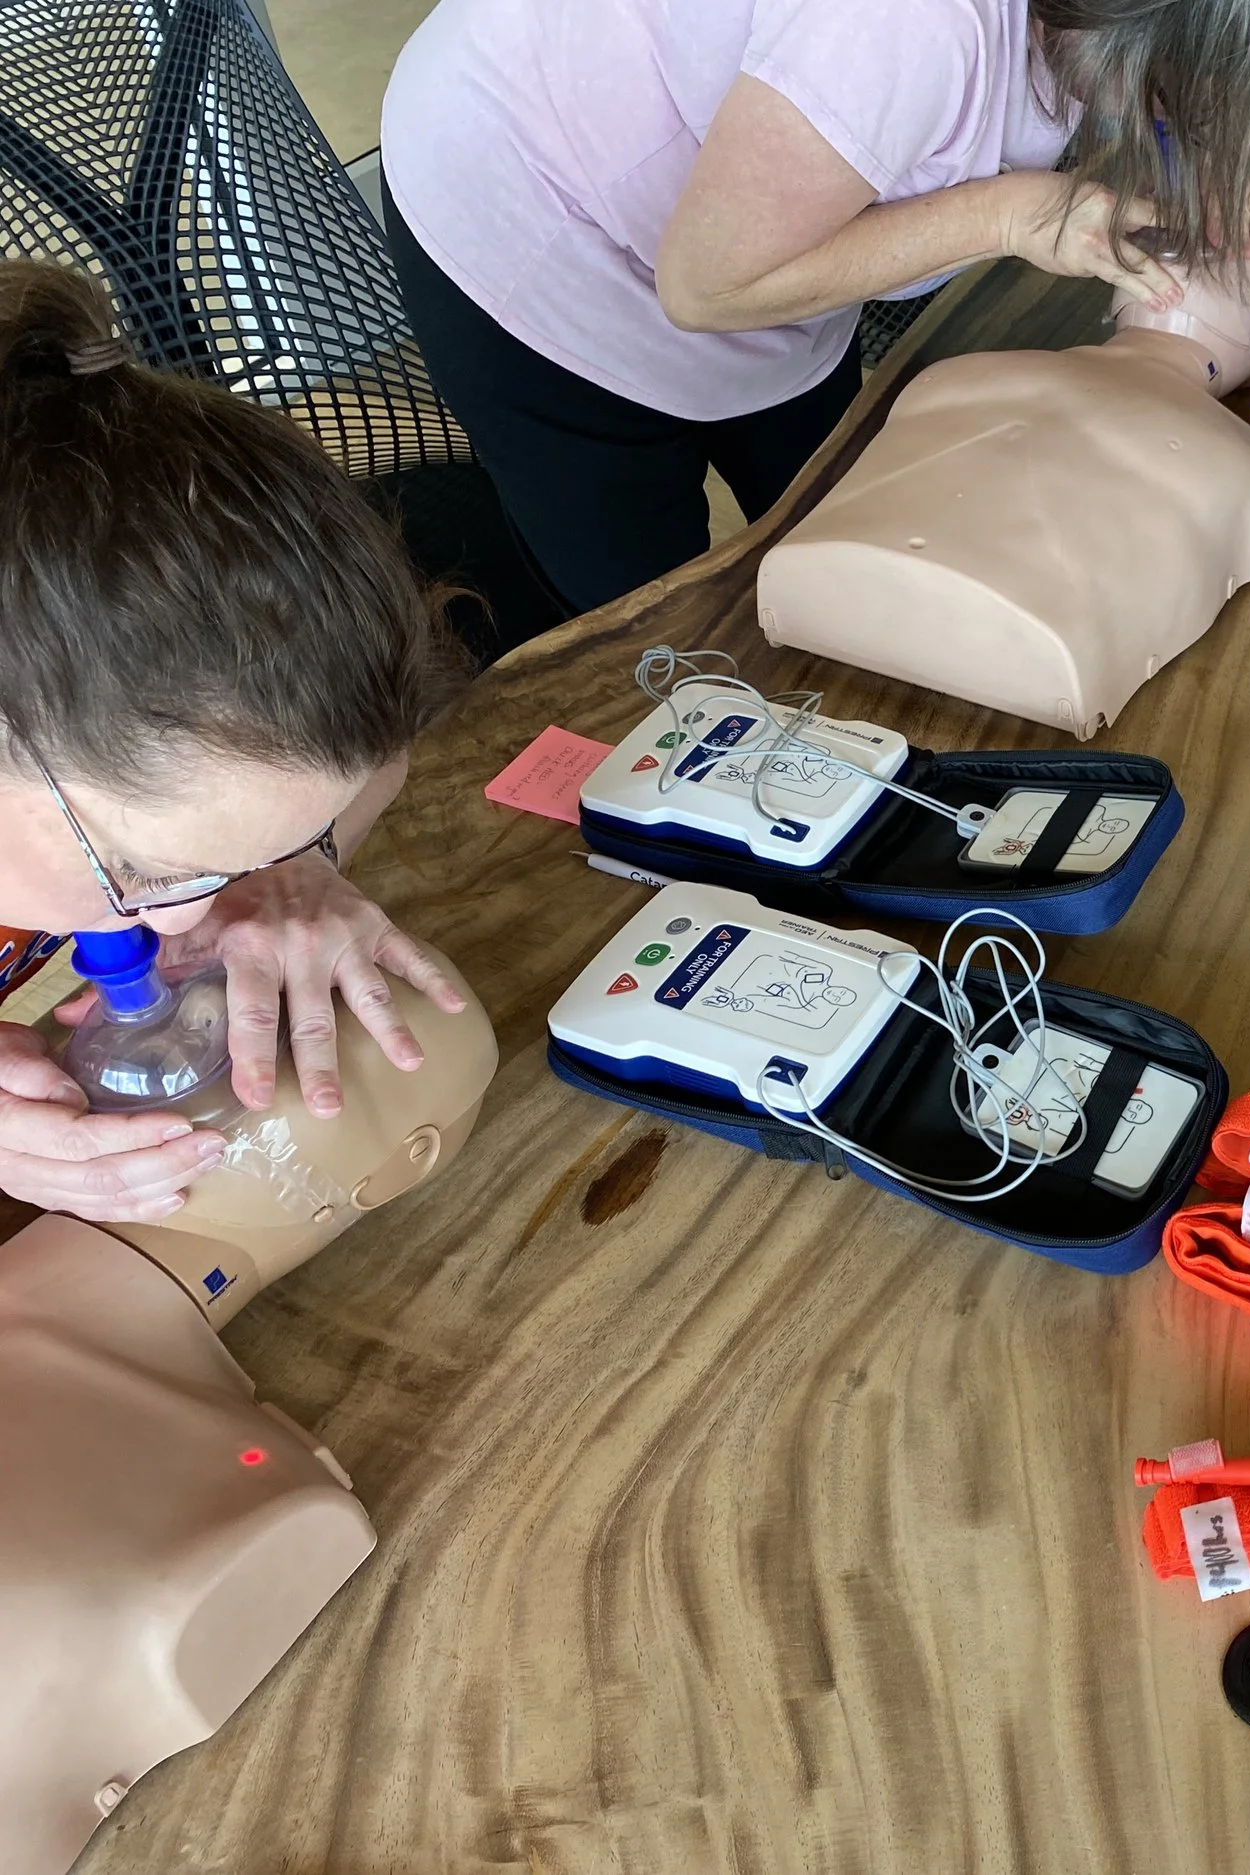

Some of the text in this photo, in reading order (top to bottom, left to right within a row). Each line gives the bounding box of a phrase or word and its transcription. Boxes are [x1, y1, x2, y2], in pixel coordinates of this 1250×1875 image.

[712, 941, 731, 957] FOR
[827, 934, 879, 958] PRESTAN
[681, 957, 719, 993] TRAINING
[686, 953, 708, 975] ONLY
